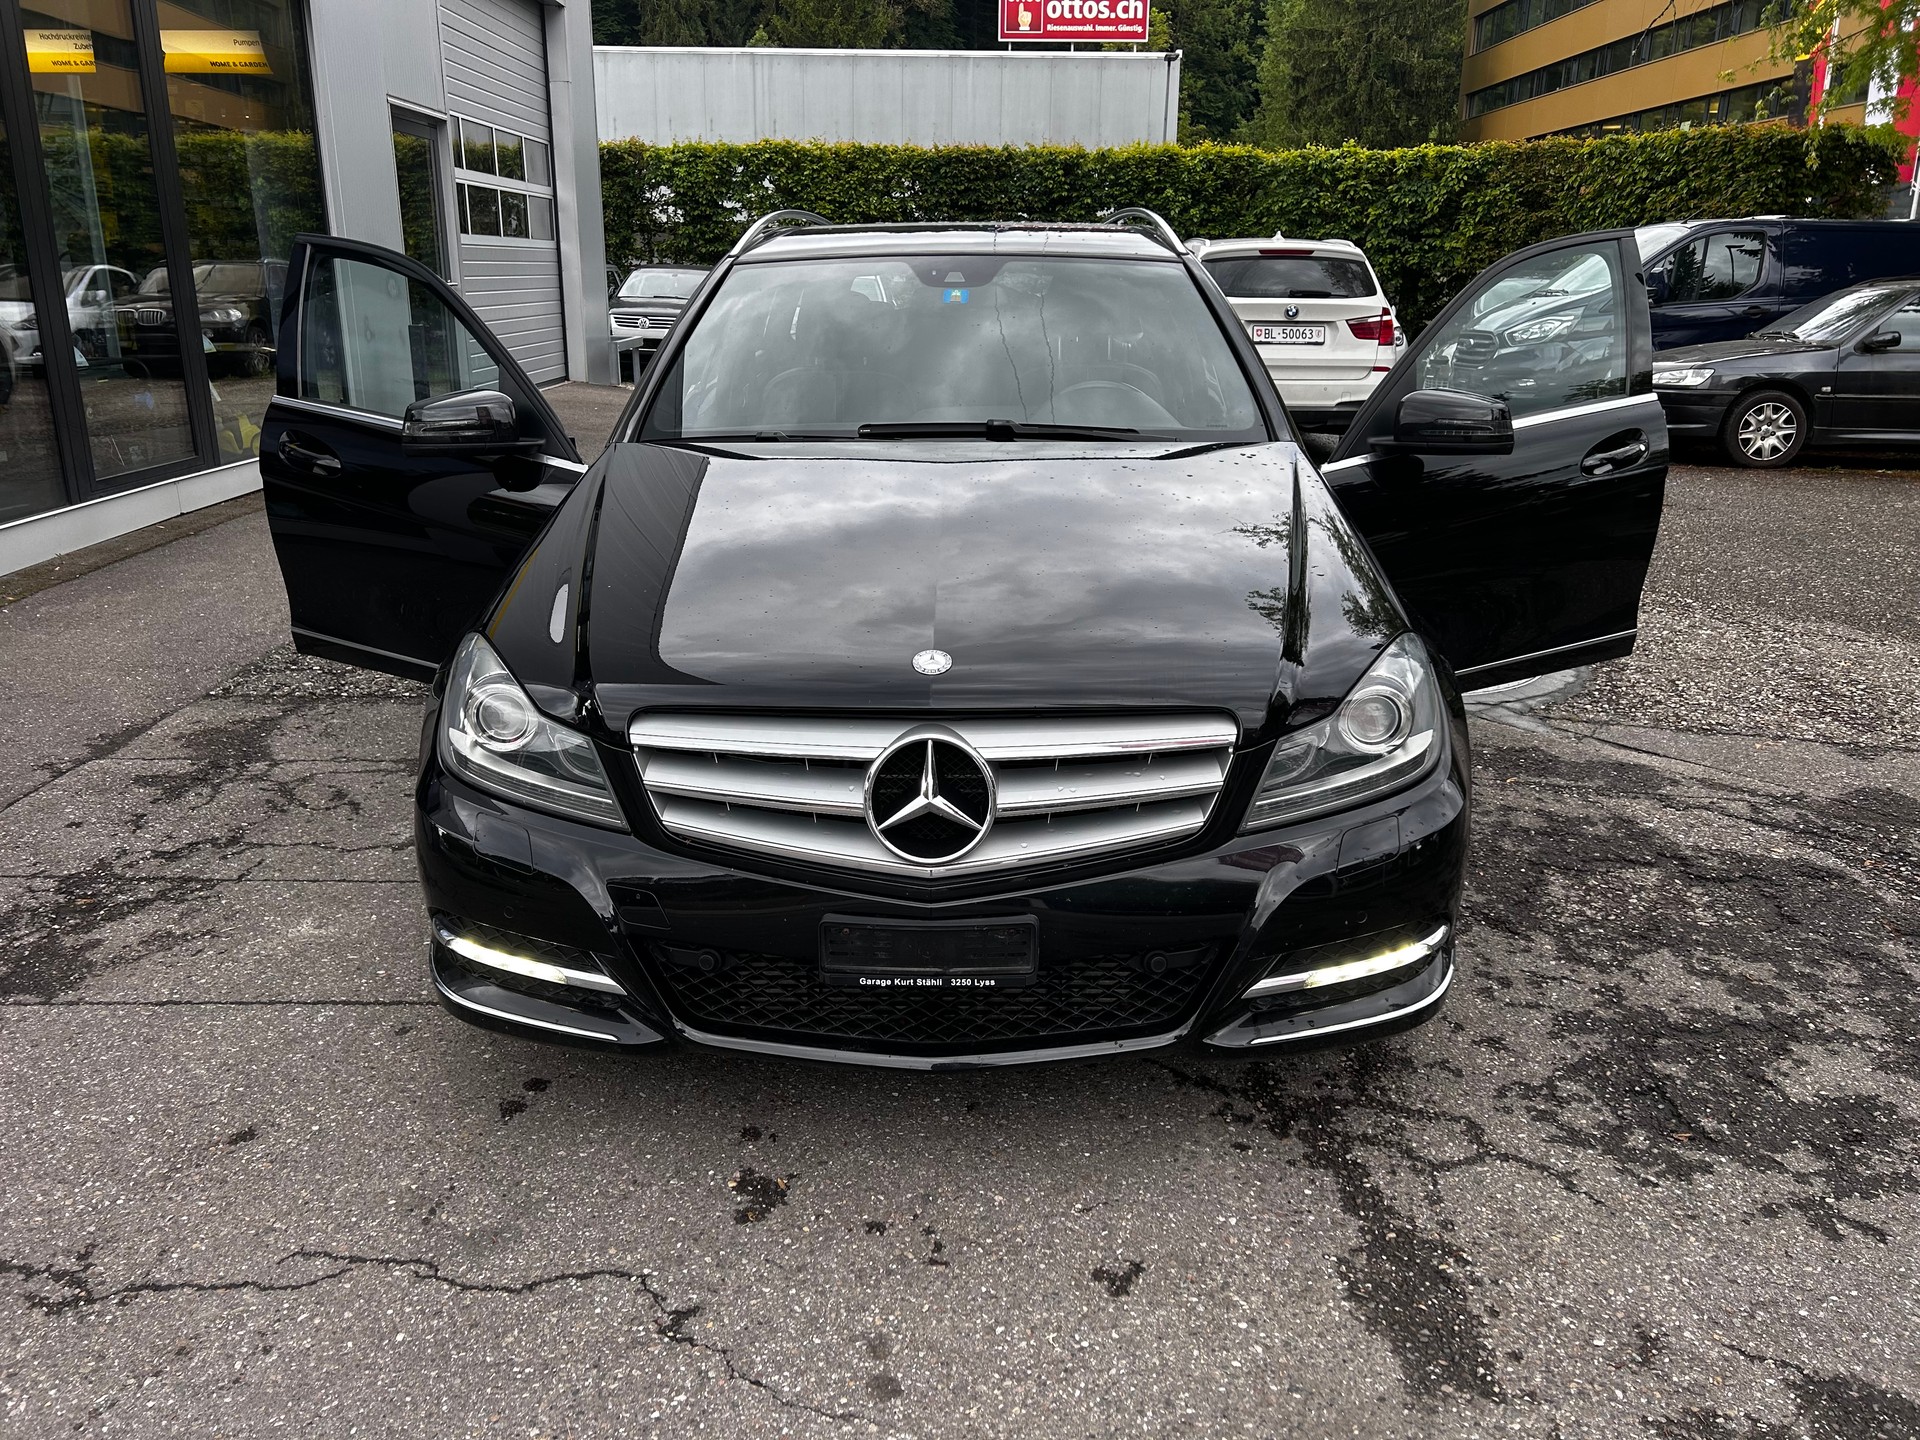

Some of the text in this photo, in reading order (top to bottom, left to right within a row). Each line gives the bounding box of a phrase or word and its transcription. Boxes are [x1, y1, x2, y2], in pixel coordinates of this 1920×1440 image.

[1046, 0, 1144, 19] ottos.ch
[1118, 24, 1144, 33] Günstig.
[859, 978, 996, 987] Garage Kurt Stähli 3250 Lyss
